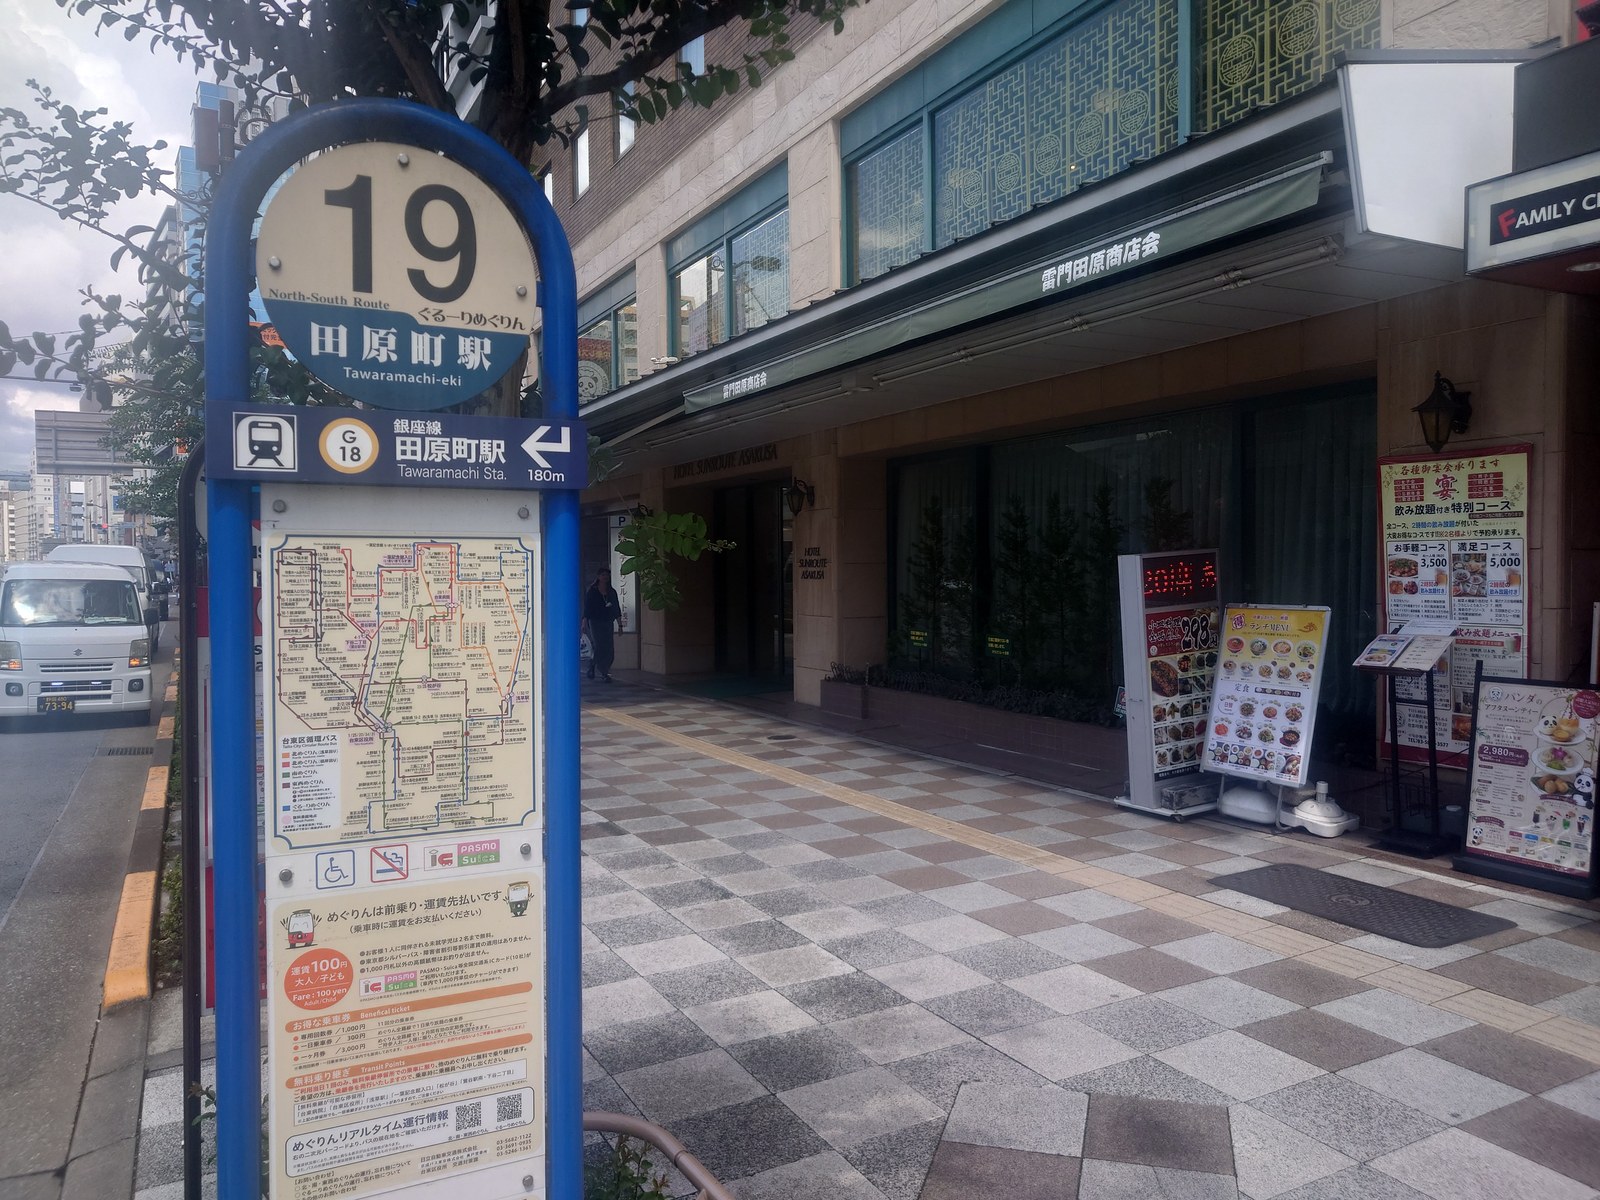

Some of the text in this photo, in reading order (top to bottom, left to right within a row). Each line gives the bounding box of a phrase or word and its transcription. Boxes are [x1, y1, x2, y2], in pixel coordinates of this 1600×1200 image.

[1498, 198, 1577, 238] FAMILY
[324, 174, 478, 304] 19
[1041, 231, 1161, 292] 雷門田原商店会
[269, 287, 391, 311] North-South Route
[417, 307, 526, 332] ぐるーりめぐりん
[310, 321, 492, 372] 田原町駅
[343, 366, 463, 387] Tawaramachi-eki
[393, 418, 443, 436] 銀座線
[341, 429, 357, 444] G
[339, 445, 362, 463] 18
[394, 435, 507, 465] 田原町駅
[398, 464, 508, 481] Tawaramachi Sta.
[528, 468, 565, 482] 180m
[1400, 458, 1500, 475] 各種御宴会承ります
[1433, 474, 1458, 500] 宴
[1394, 500, 1512, 516] 飲み放題付き特別コース
[618, 516, 626, 526] P
[1394, 543, 1446, 552] お手軽コース
[1458, 542, 1512, 552] 満足コース
[1421, 558, 1447, 568] 3,500
[1490, 557, 1521, 567] 5,000
[45, 701, 73, 711] 73-94
[1505, 693, 1543, 705] パンダの
[282, 735, 337, 744] 台東区循環バス
[460, 841, 498, 854] PASMO
[462, 853, 497, 866] Suica
[327, 889, 501, 923] めぐりんは前乗り・運賃先払いです
[387, 972, 414, 982] PASMO
[293, 992, 310, 1001] Fare
[333, 987, 346, 996] yen
[293, 1013, 350, 1031] お得な乗車券
[391, 1004, 409, 1013] ticket
[294, 1060, 404, 1086] 無料乗り継ぎ Transit Points
[292, 1110, 448, 1152] めぐりんリアルタイム運行情報
